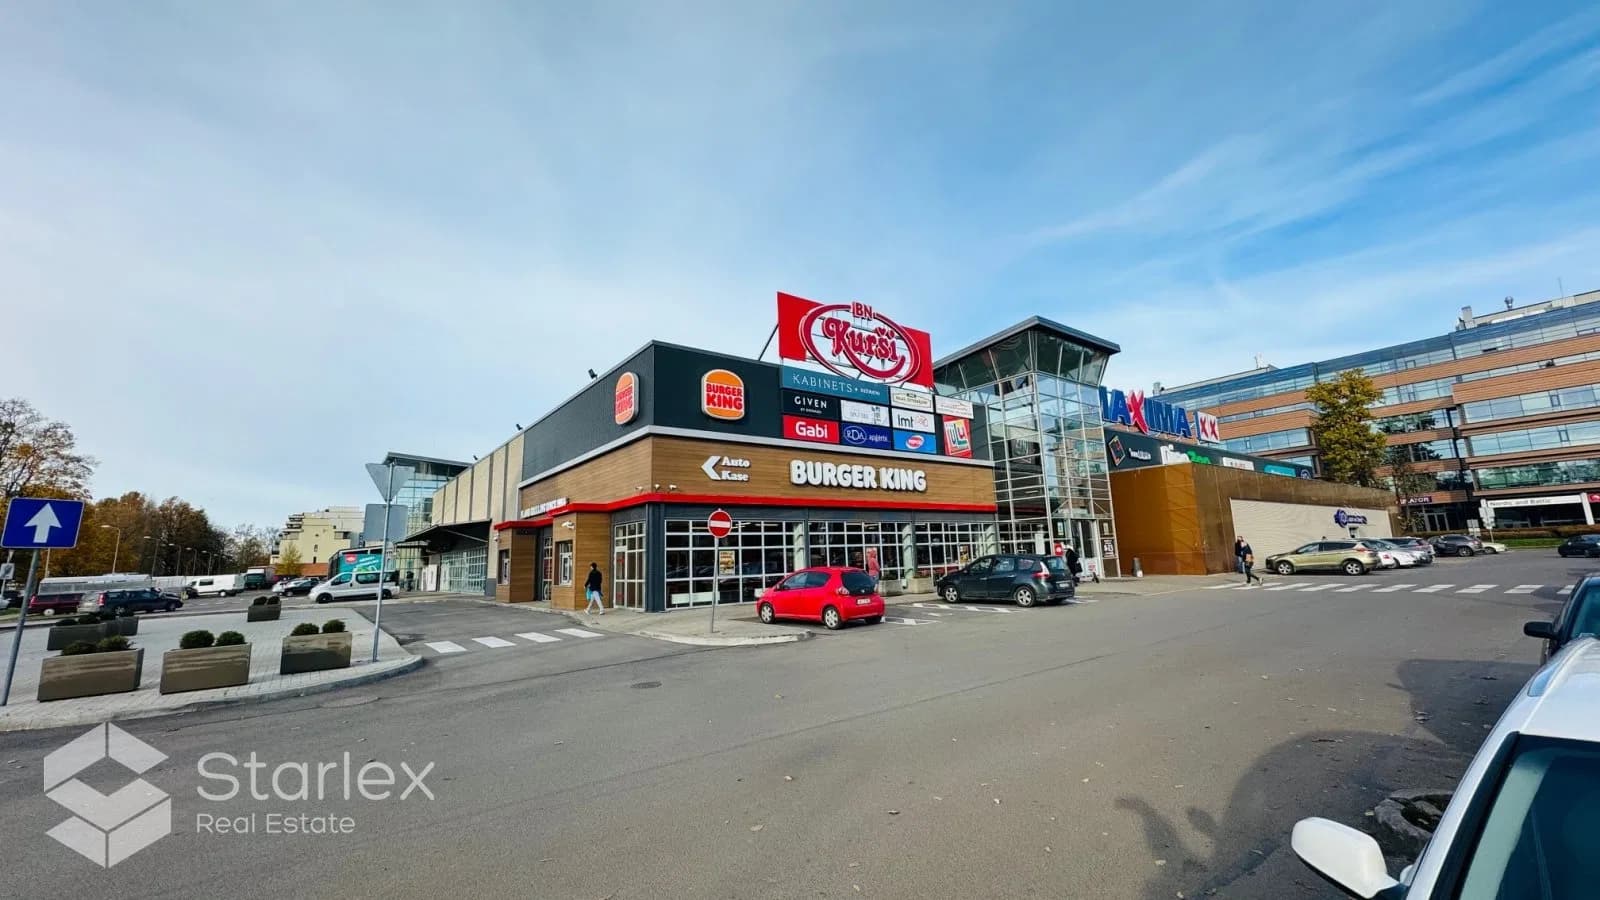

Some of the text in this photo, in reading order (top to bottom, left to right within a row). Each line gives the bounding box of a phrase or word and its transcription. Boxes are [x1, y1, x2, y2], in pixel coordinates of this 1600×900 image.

[822, 316, 905, 372] Kurši
[706, 383, 743, 397] BURGER
[793, 373, 852, 393] KABINETS
[706, 393, 743, 410] KING
[794, 396, 827, 408] GIVEN
[795, 421, 828, 439] Gabi
[846, 429, 865, 441] RDA
[1200, 416, 1219, 440] XX
[721, 456, 750, 468] Auto
[721, 470, 749, 481] Kase
[790, 459, 926, 491] BURGER KING
